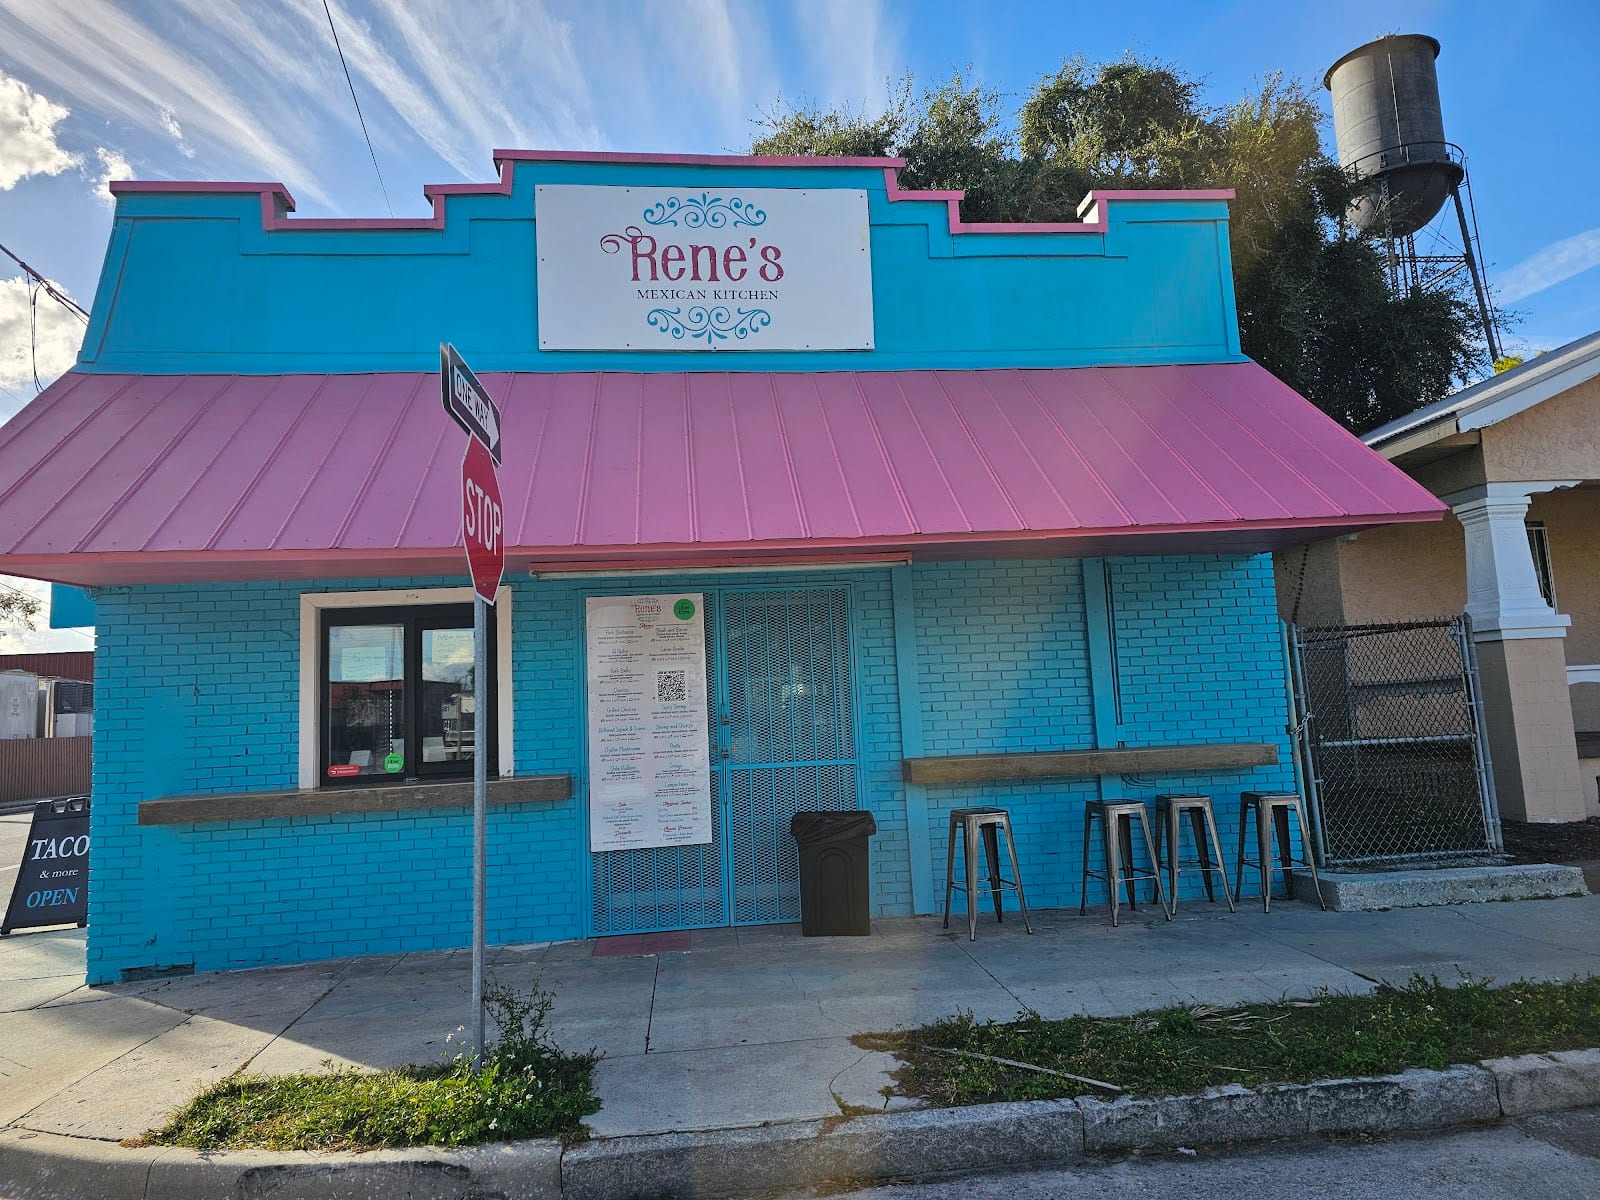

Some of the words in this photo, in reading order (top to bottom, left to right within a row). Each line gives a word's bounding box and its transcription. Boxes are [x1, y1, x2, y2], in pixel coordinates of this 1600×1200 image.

[600, 226, 785, 282] Rene's
[637, 289, 706, 300] MEXICAN
[713, 290, 779, 301] KITCHEN
[456, 372, 473, 411] ONE
[474, 396, 489, 431] WAY
[465, 478, 501, 555] STOP
[31, 835, 90, 861] TACO
[39, 870, 50, 879] &
[51, 868, 79, 879] more
[26, 886, 80, 909] OPEN
